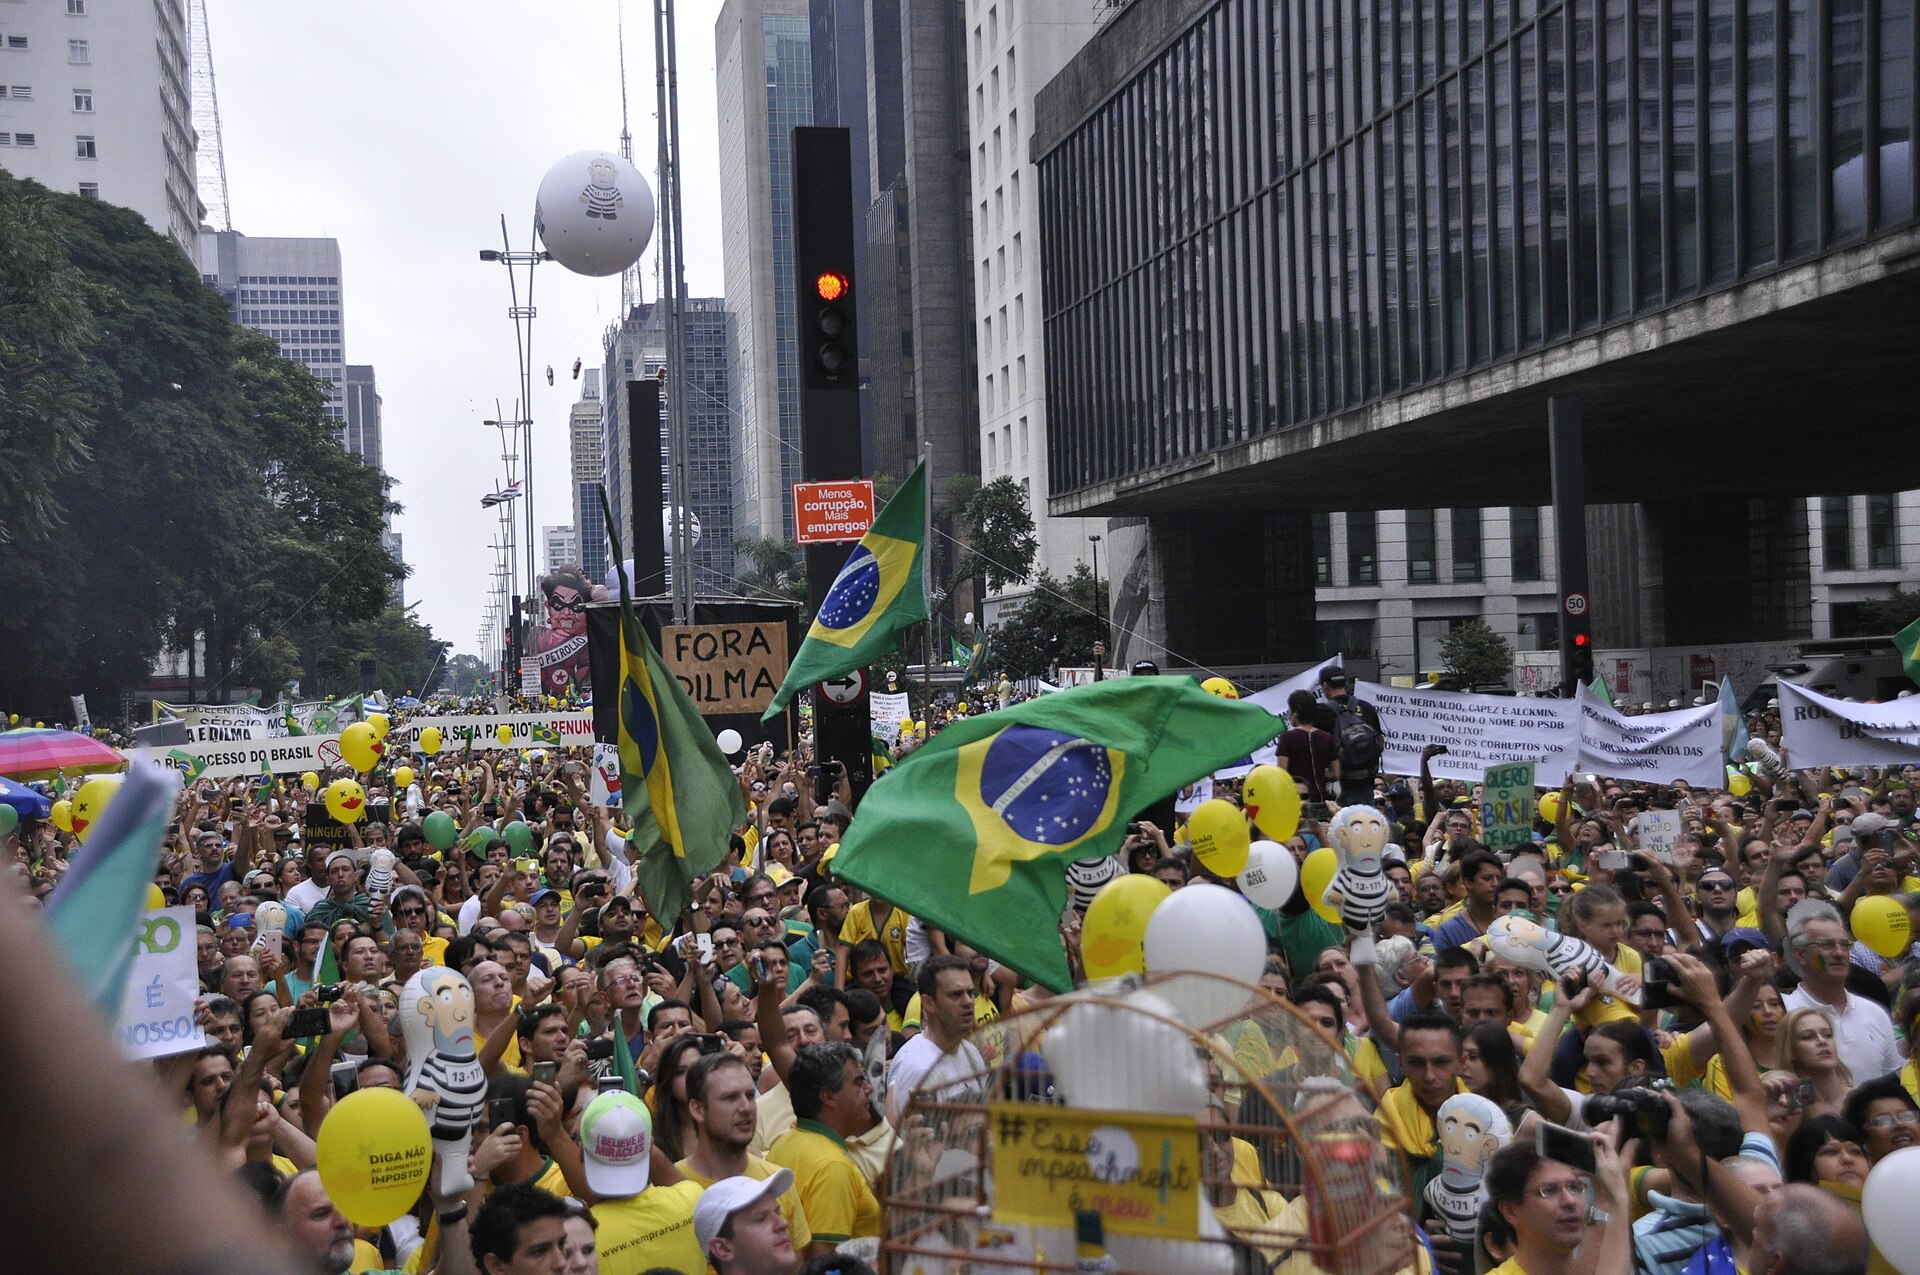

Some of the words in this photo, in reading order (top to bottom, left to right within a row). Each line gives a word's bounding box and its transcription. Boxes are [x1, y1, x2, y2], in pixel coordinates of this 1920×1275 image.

[818, 489, 853, 500] Menos
[804, 498, 867, 512] corrupção,
[825, 510, 849, 521] Mais
[807, 519, 869, 534] empregos!
[1568, 598, 1584, 609] 50
[675, 626, 772, 662] FORA
[1376, 693, 1407, 706] MOITA,
[1410, 697, 1465, 712] MERIVALDO,
[1468, 703, 1499, 715] CAPEZ
[1502, 706, 1508, 715] E
[1510, 707, 1558, 718] ALCKMIN:
[1374, 704, 1397, 716] OCÊS
[1399, 707, 1429, 720] ESTÃO
[1432, 711, 1476, 725] JOGANDO
[1478, 717, 1486, 725] O
[1488, 717, 1516, 728] NOME
[1519, 719, 1534, 729] DO
[1537, 720, 1565, 730] PSDB
[209, 727, 252, 742] DILMA
[1441, 724, 1455, 734] NO
[1458, 726, 1484, 736] LIXO!
[1401, 731, 1426, 742] PARA
[1429, 734, 1461, 746] TODOS
[1464, 738, 1477, 747] OS
[1480, 740, 1540, 752] CORRUPTOS
[1542, 743, 1564, 753] NOS
[250, 750, 267, 762] DO
[271, 746, 313, 761] BRASIL
[1384, 741, 1425, 754] OVERNO
[1541, 755, 1548, 763] E
[1683, 746, 1703, 757] DAS
[1437, 758, 1483, 771] FEDERAL.
[1486, 767, 1530, 788] QUERO
[1482, 797, 1534, 829] BRASIL
[1483, 829, 1499, 847] DE
[1500, 826, 1532, 846] VOLTA
[1082, 868, 1108, 881] 13-171
[1245, 868, 1263, 880] MAIS
[1246, 875, 1267, 888] MISES
[1355, 881, 1381, 891] 13-171
[146, 974, 165, 1009] É
[600, 1135, 637, 1148] BELIEVE
[369, 1151, 403, 1165] DIGA
[405, 1145, 426, 1159] NÃO
[594, 1143, 645, 1158] MIRACLES
[385, 1160, 418, 1172] AUMENTO
[371, 1167, 423, 1185] IMPOSTOS
